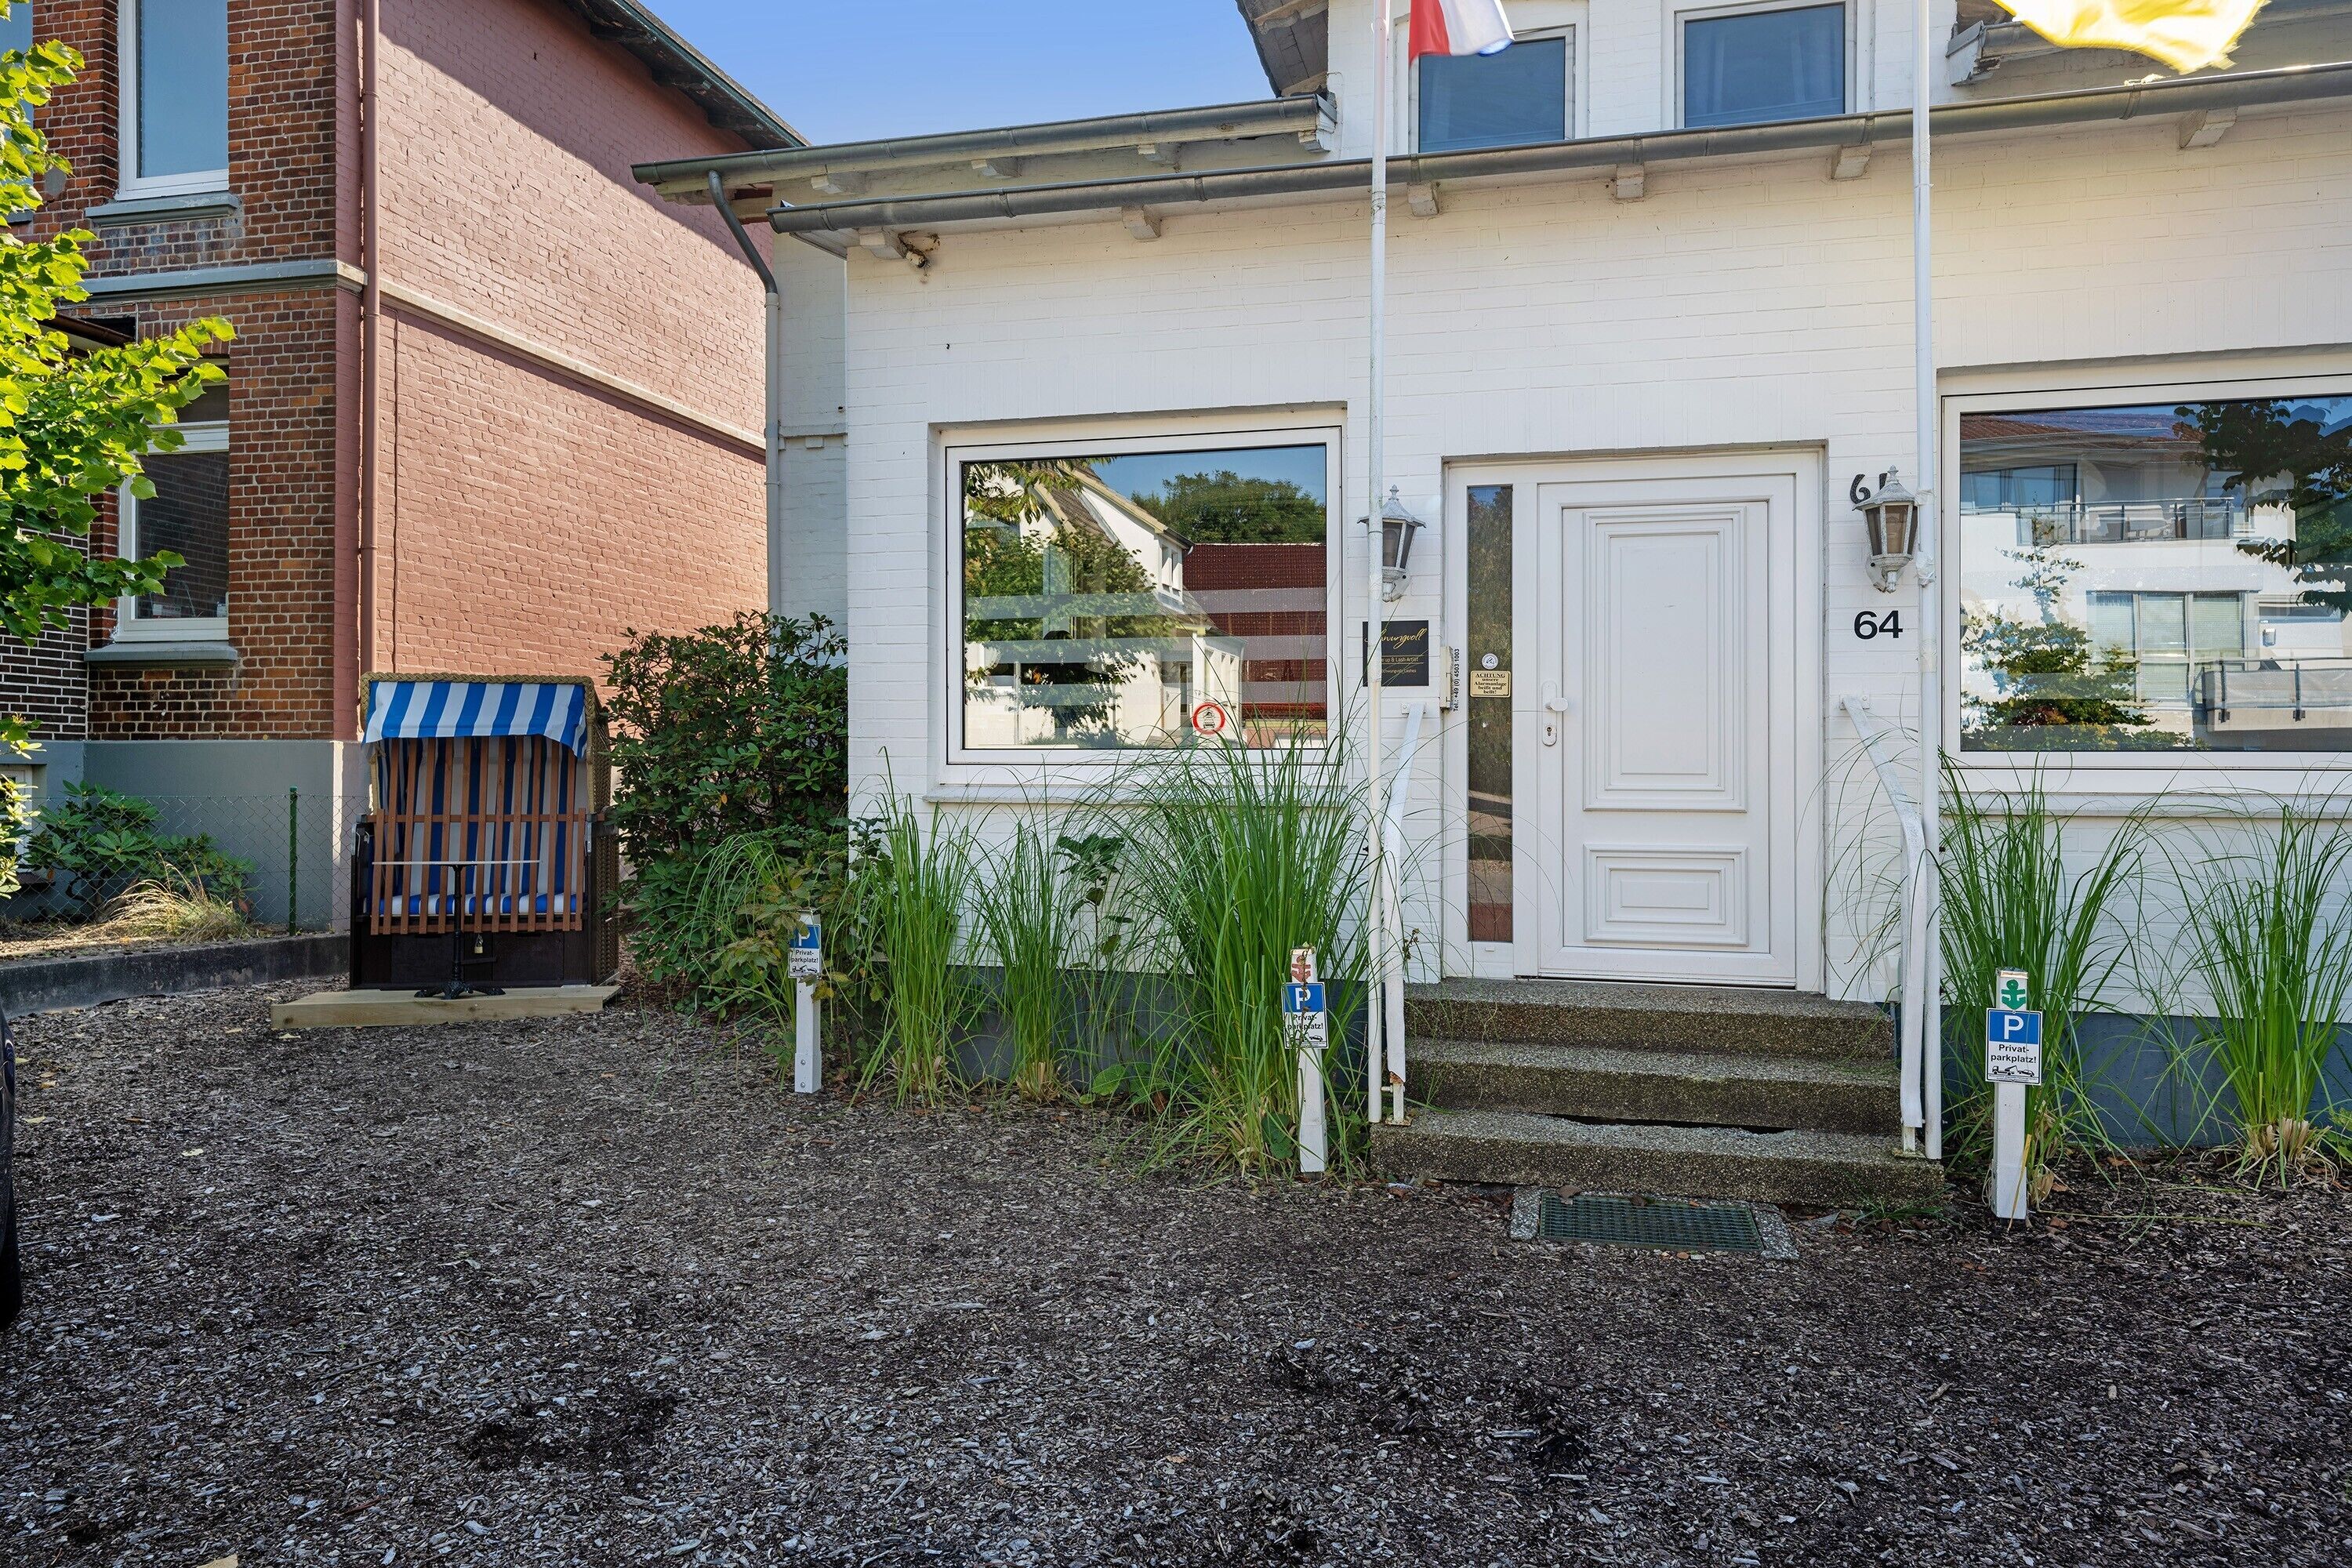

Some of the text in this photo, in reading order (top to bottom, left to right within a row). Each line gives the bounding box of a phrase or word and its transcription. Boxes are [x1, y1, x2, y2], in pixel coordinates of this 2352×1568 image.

[1854, 610, 1903, 640] 64
[1294, 987, 1312, 1011] P
[2003, 1014, 2024, 1040] P
[1991, 1054, 2037, 1064] parkplatz!
[1998, 1044, 2030, 1053] Privat-
